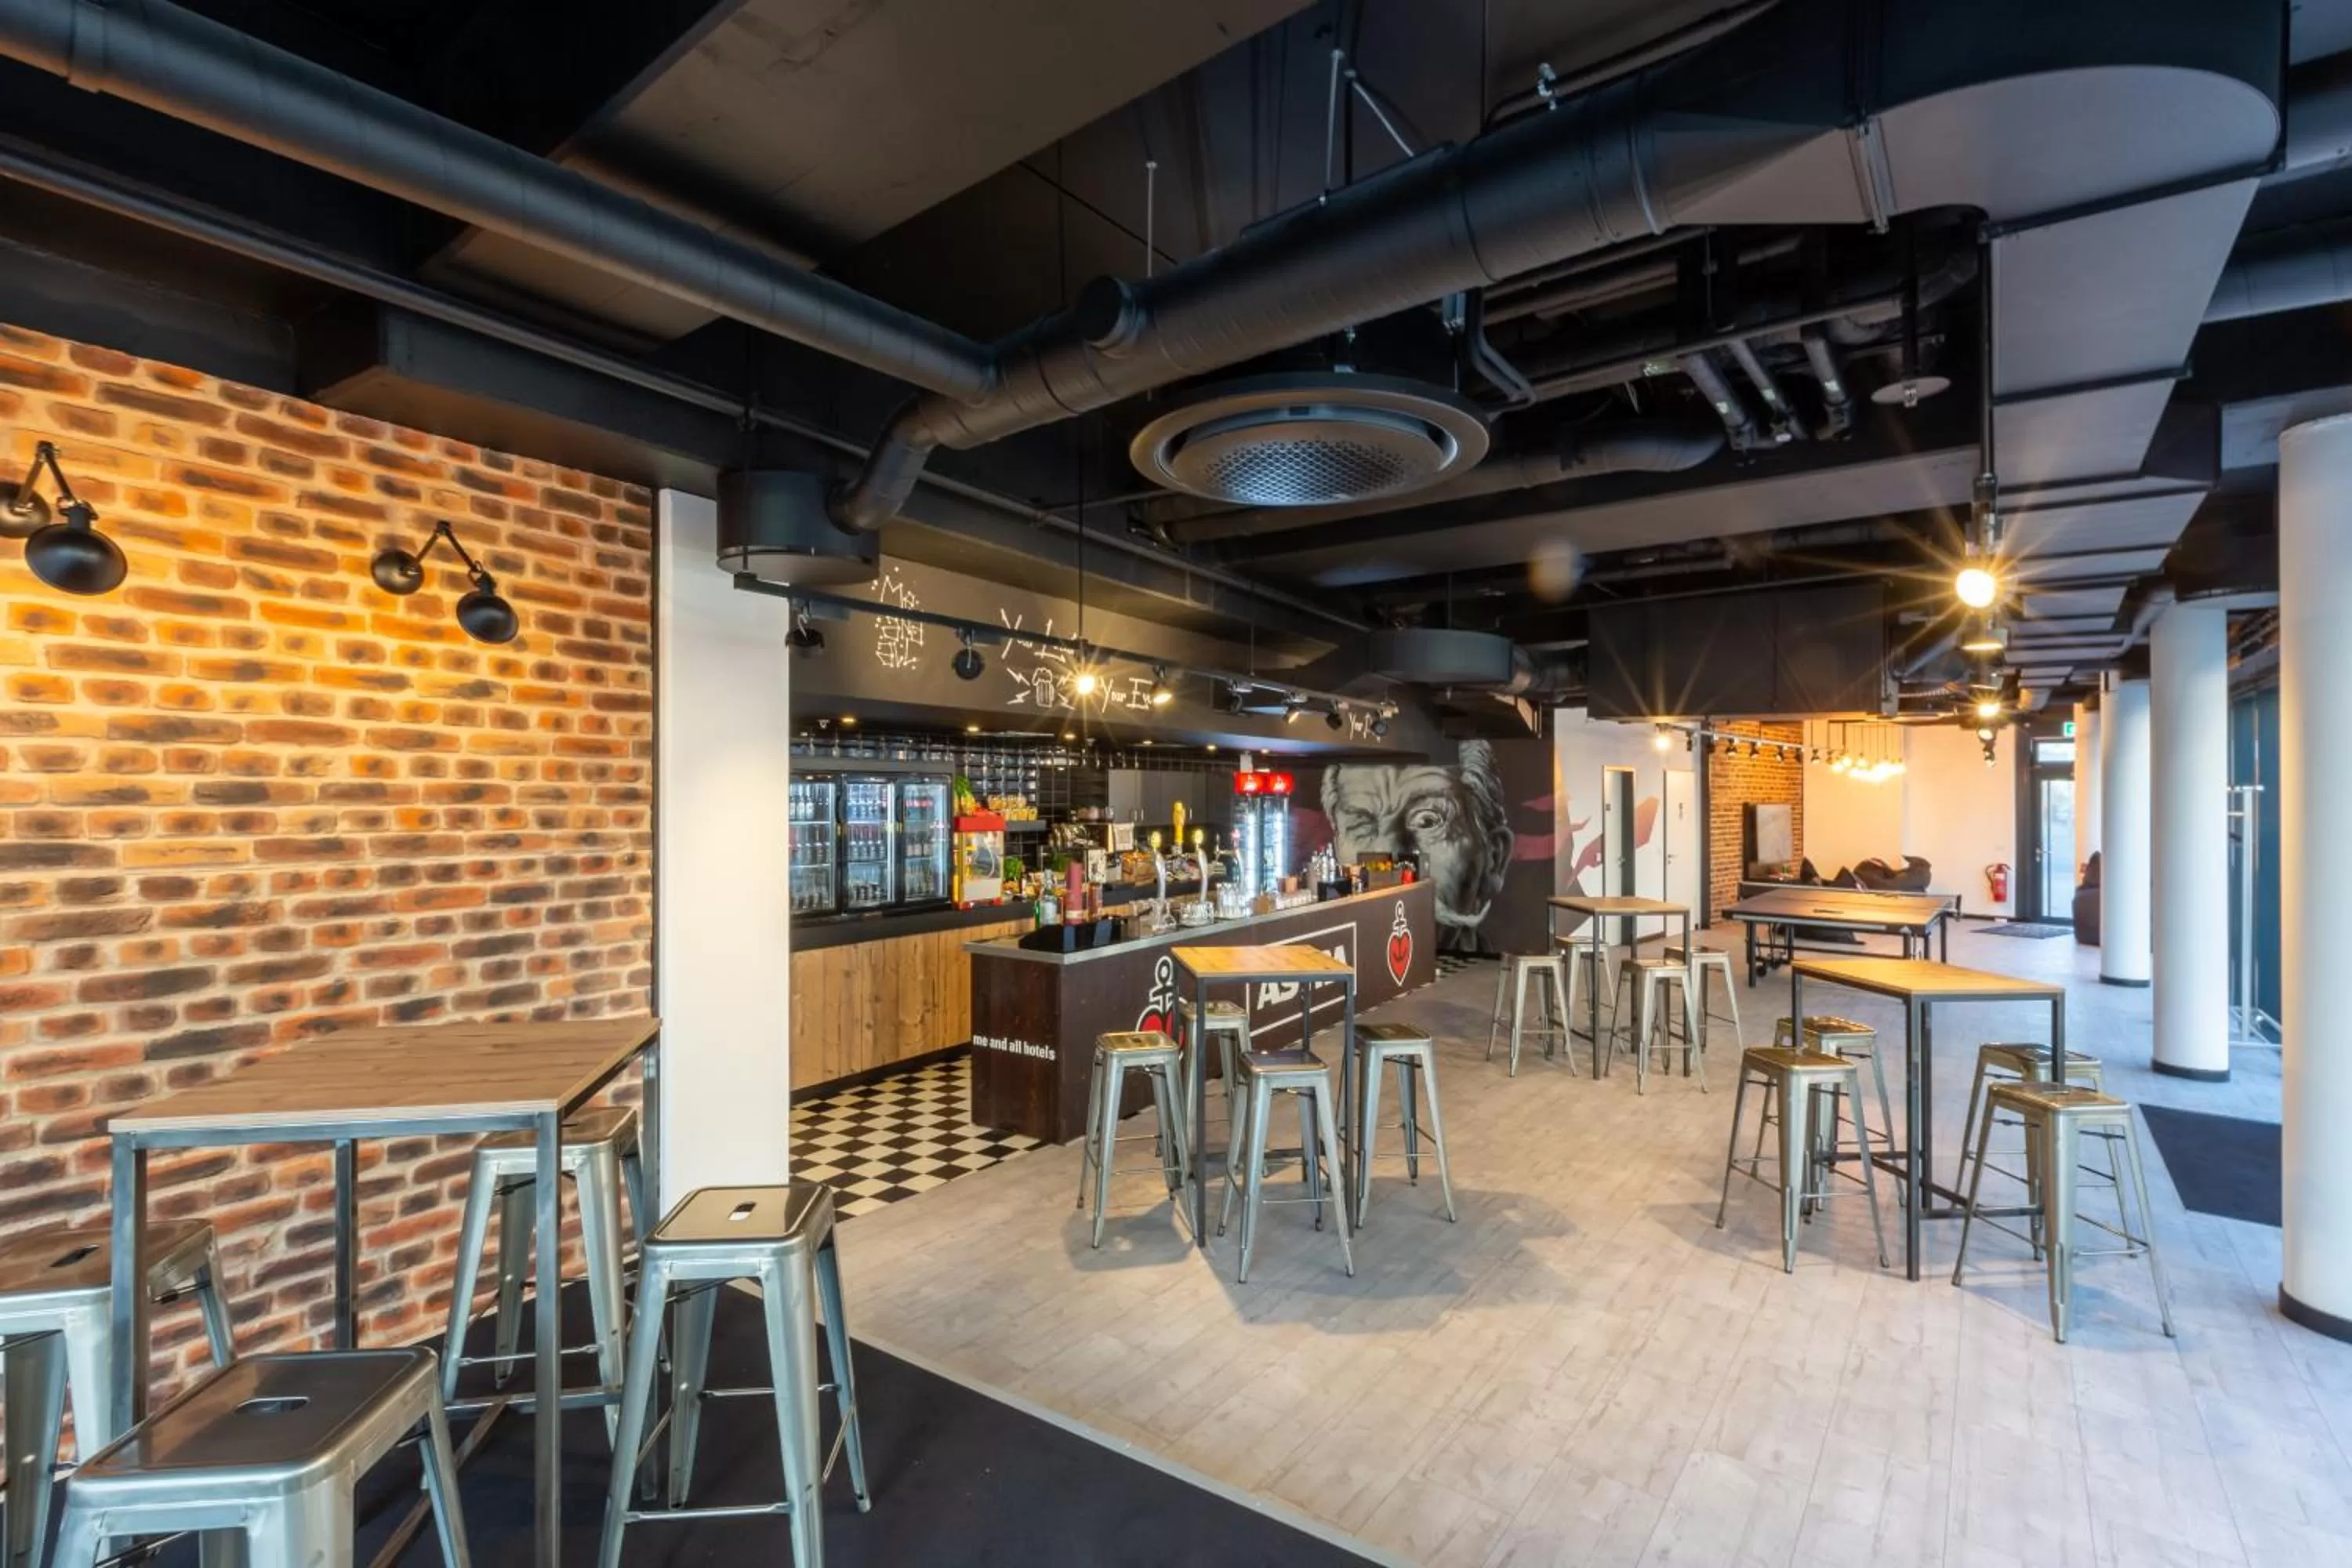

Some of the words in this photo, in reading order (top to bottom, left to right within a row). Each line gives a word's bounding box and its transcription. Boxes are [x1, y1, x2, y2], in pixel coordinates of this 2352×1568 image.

[973, 1034, 989, 1047] me
[989, 1037, 1007, 1051] and
[1009, 1040, 1022, 1054] all
[1023, 1040, 1056, 1061] hotels
